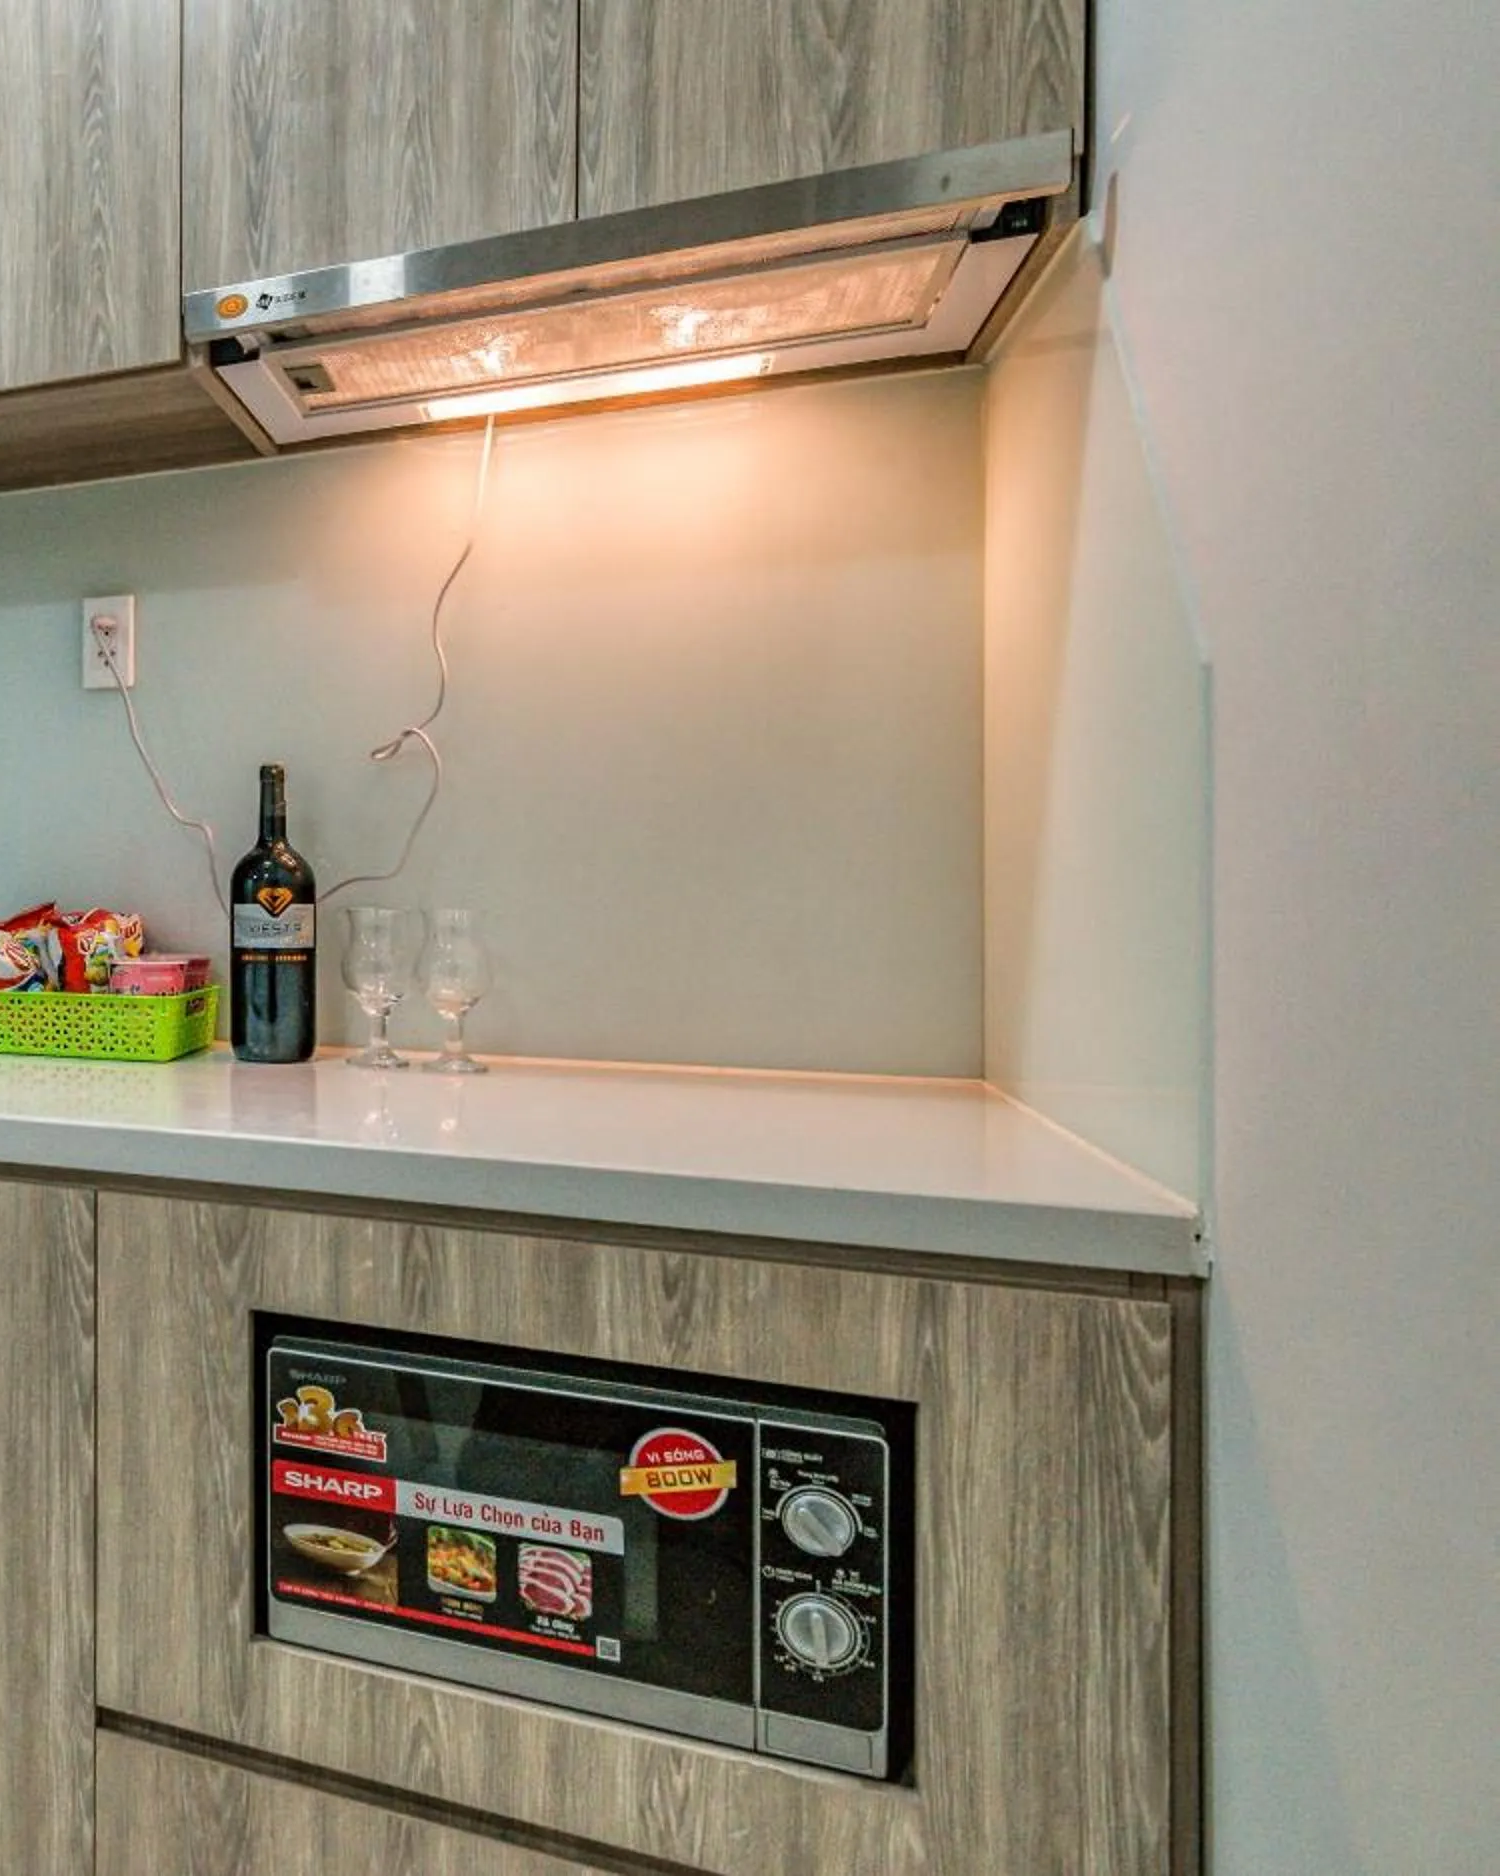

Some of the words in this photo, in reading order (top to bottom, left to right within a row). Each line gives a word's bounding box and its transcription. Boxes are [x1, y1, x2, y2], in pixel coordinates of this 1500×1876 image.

[645, 1451, 661, 1464] VI
[663, 1447, 705, 1463] SÓNG
[284, 1470, 383, 1500] SHARP
[645, 1467, 713, 1489] 800W
[414, 1491, 436, 1515] Sự
[443, 1498, 474, 1521] Lựa
[480, 1503, 525, 1528] Chọn
[530, 1511, 563, 1535] của
[569, 1519, 606, 1543] Bạn
